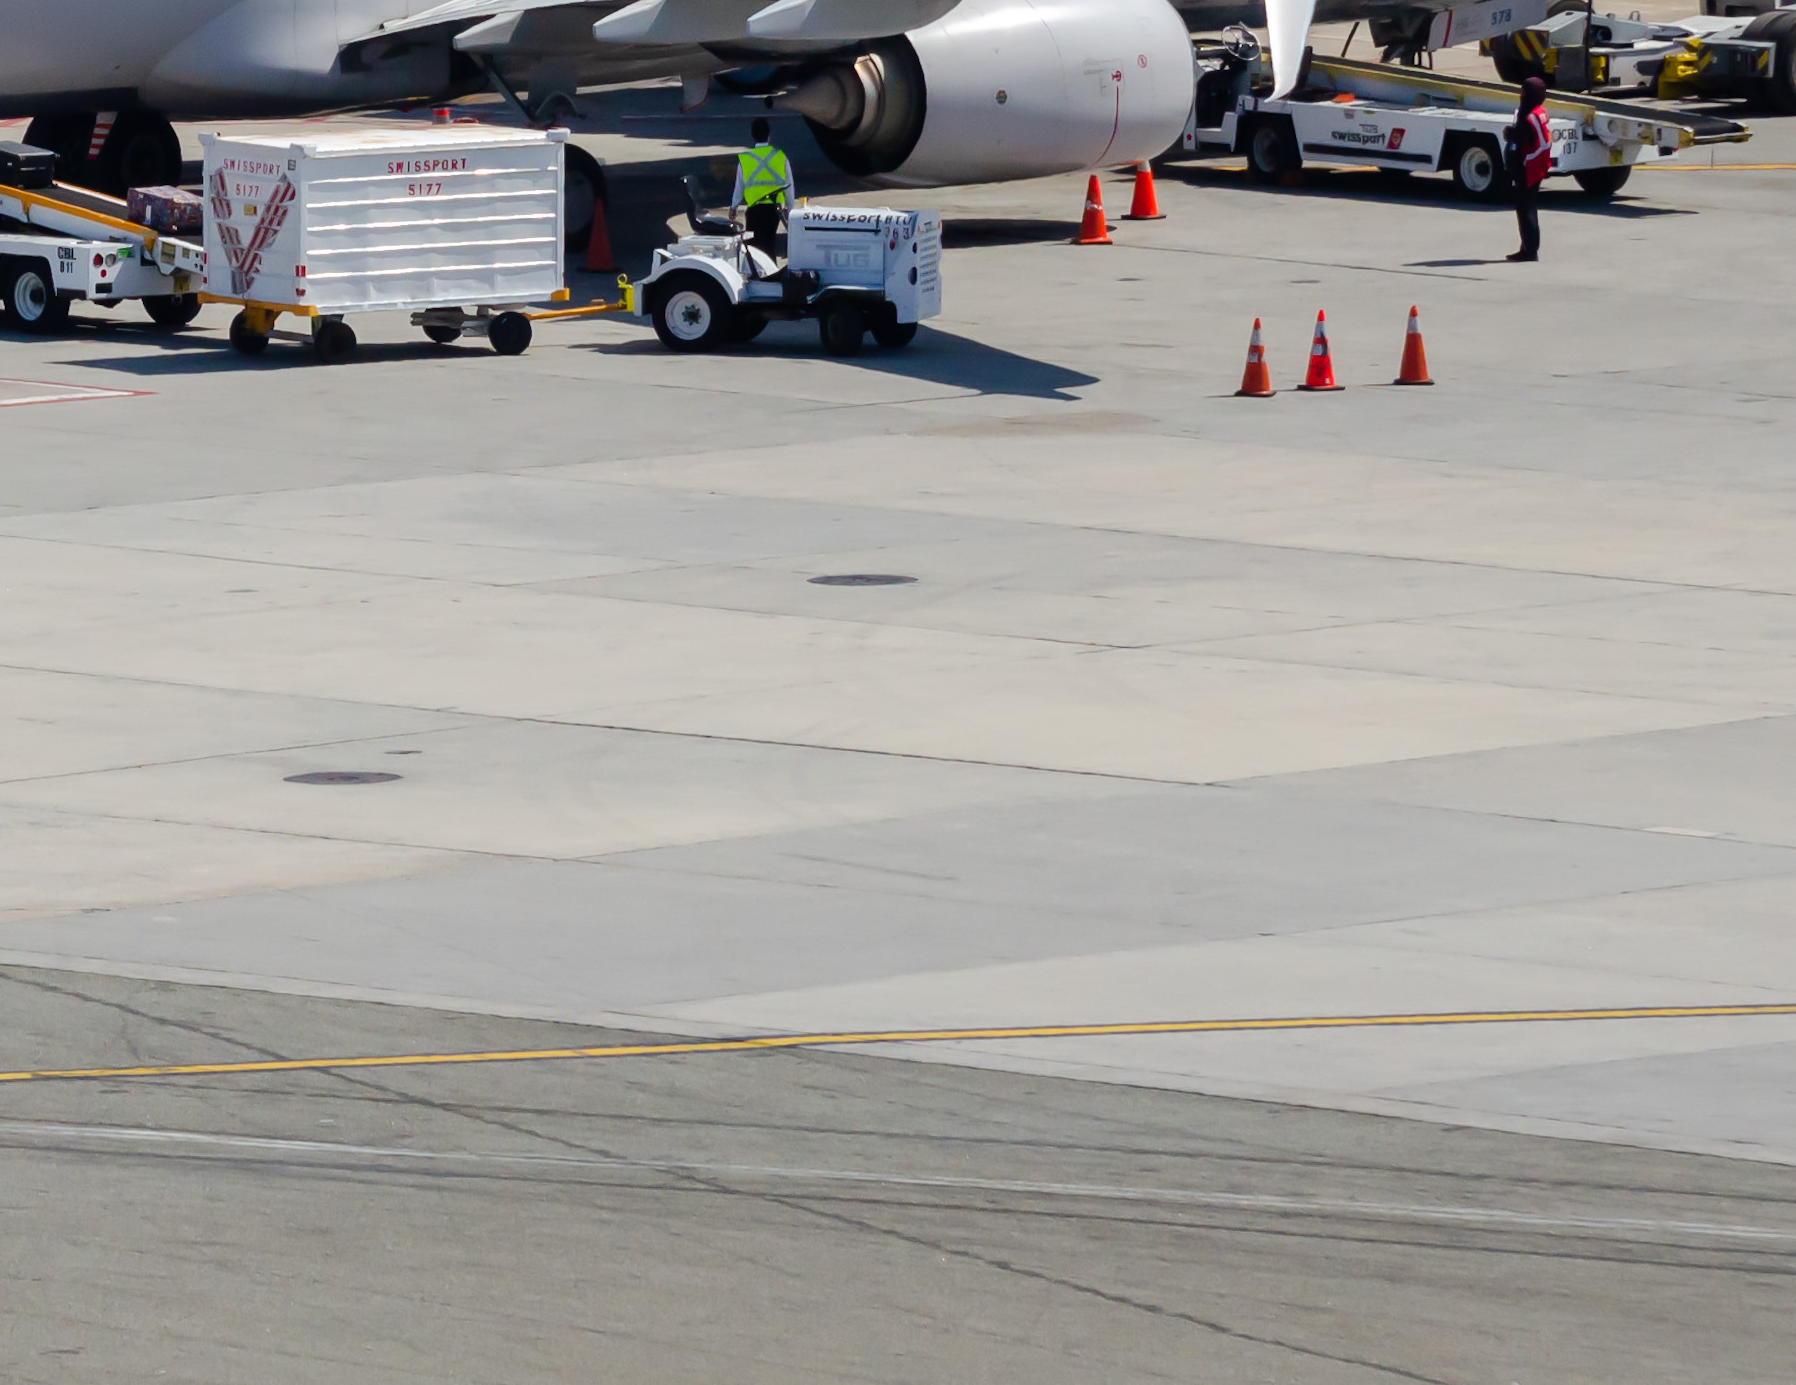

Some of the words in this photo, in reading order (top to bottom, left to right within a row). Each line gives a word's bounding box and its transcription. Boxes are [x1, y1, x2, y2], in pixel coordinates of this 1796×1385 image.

[223, 157, 281, 176] SWISSPORT
[387, 157, 468, 174] SWISSPORT
[408, 182, 443, 196] 5177
[57, 246, 77, 261] CBL
